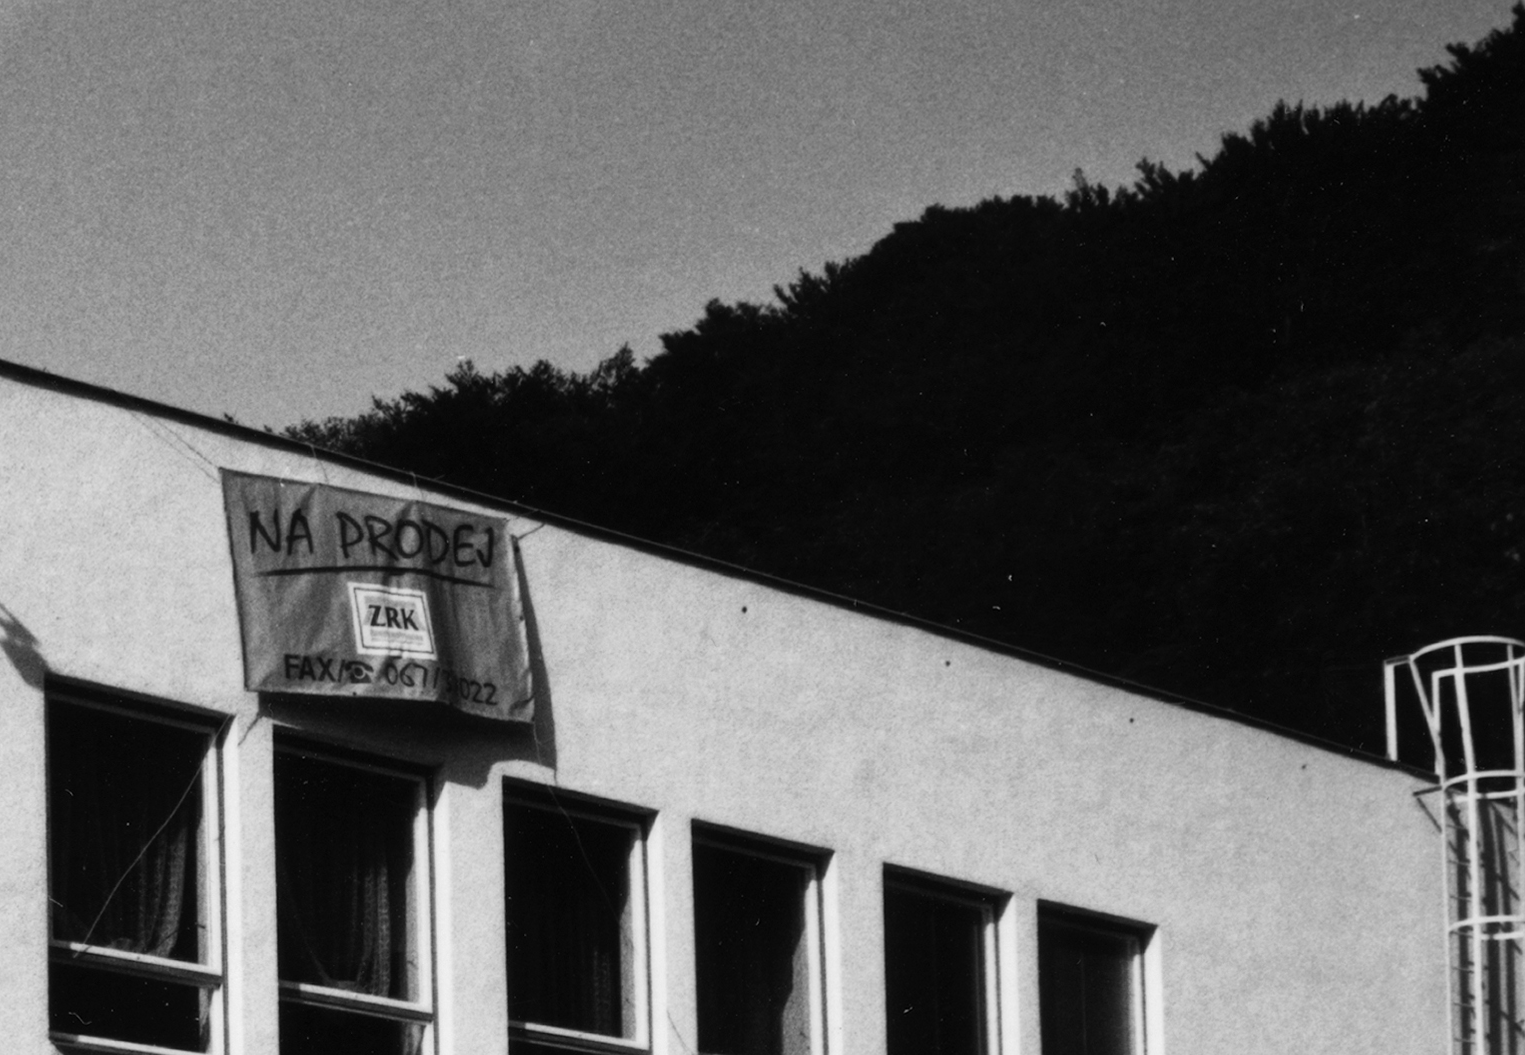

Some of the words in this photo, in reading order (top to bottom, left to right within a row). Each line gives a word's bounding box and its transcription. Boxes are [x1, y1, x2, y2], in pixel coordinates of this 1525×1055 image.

[249, 508, 314, 555] NA
[336, 511, 494, 568] PRODEJ
[368, 604, 419, 631] ZRK
